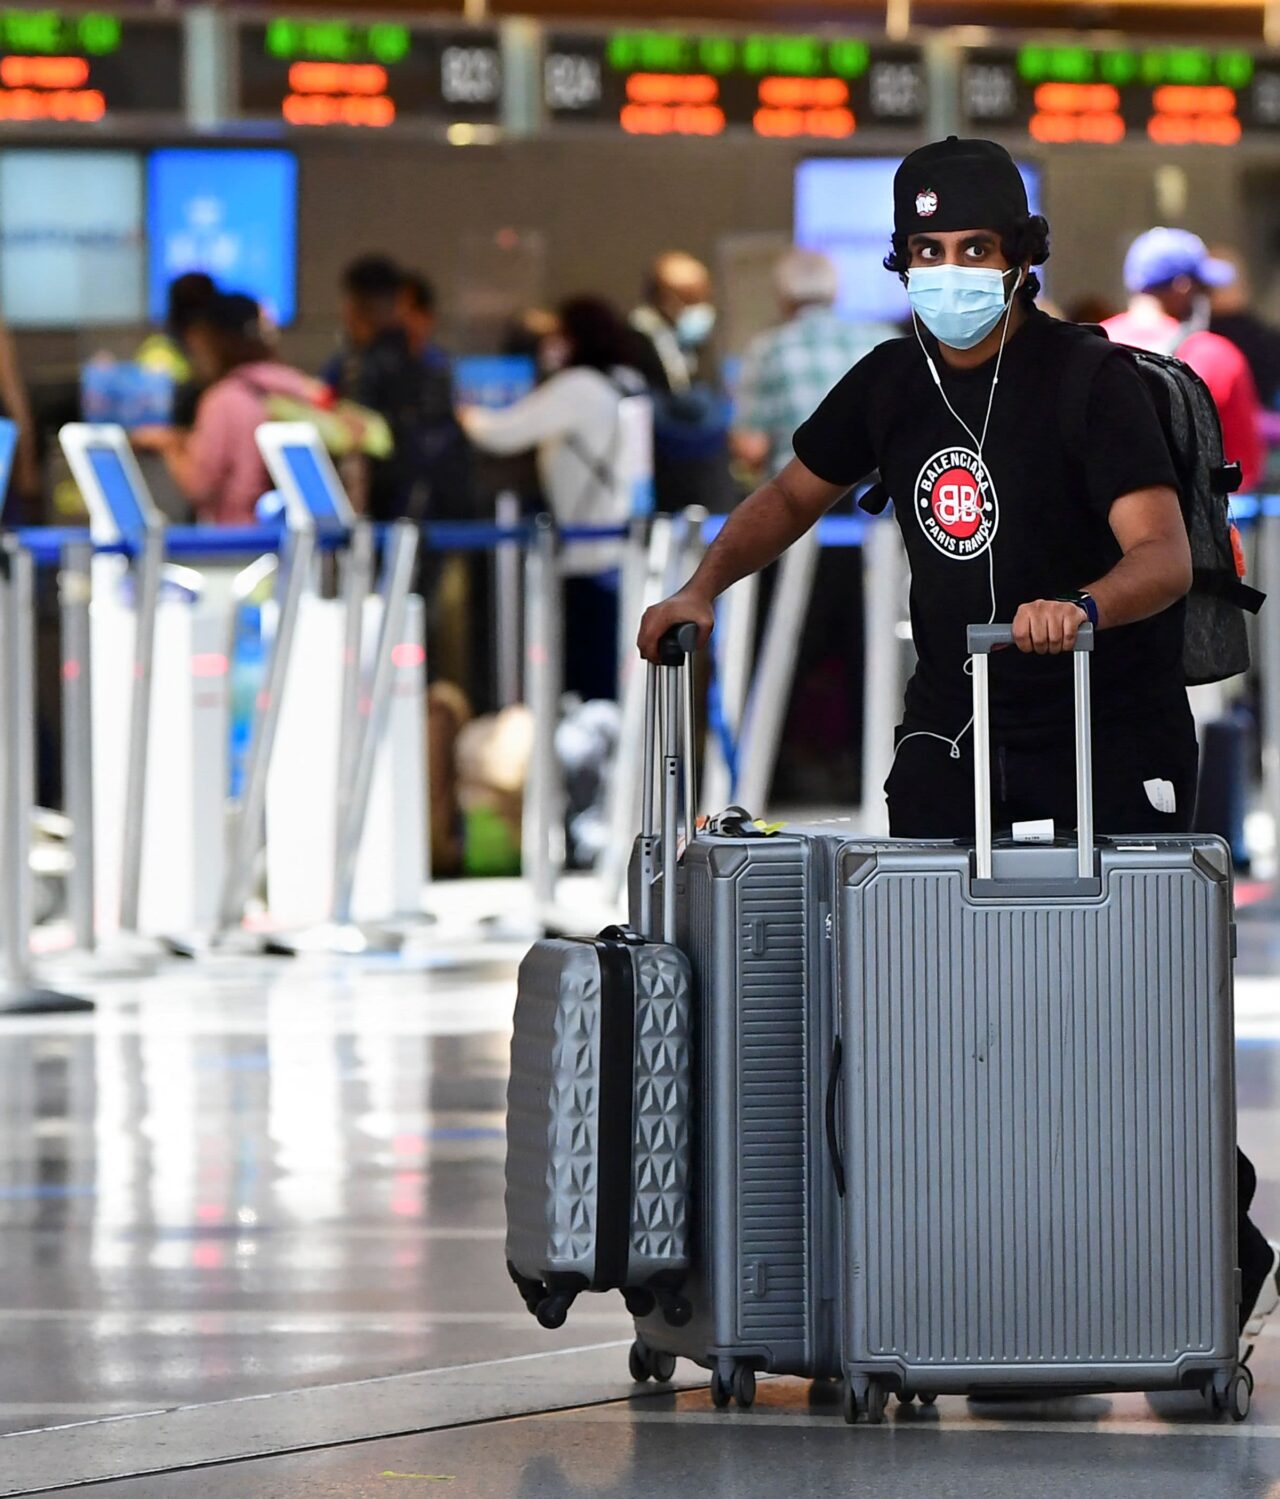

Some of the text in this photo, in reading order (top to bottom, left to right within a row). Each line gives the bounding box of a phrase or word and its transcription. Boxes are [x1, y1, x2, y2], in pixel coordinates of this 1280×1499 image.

[920, 452, 989, 492] BALENCIAGA
[925, 517, 993, 554] PARIS FRANCE
